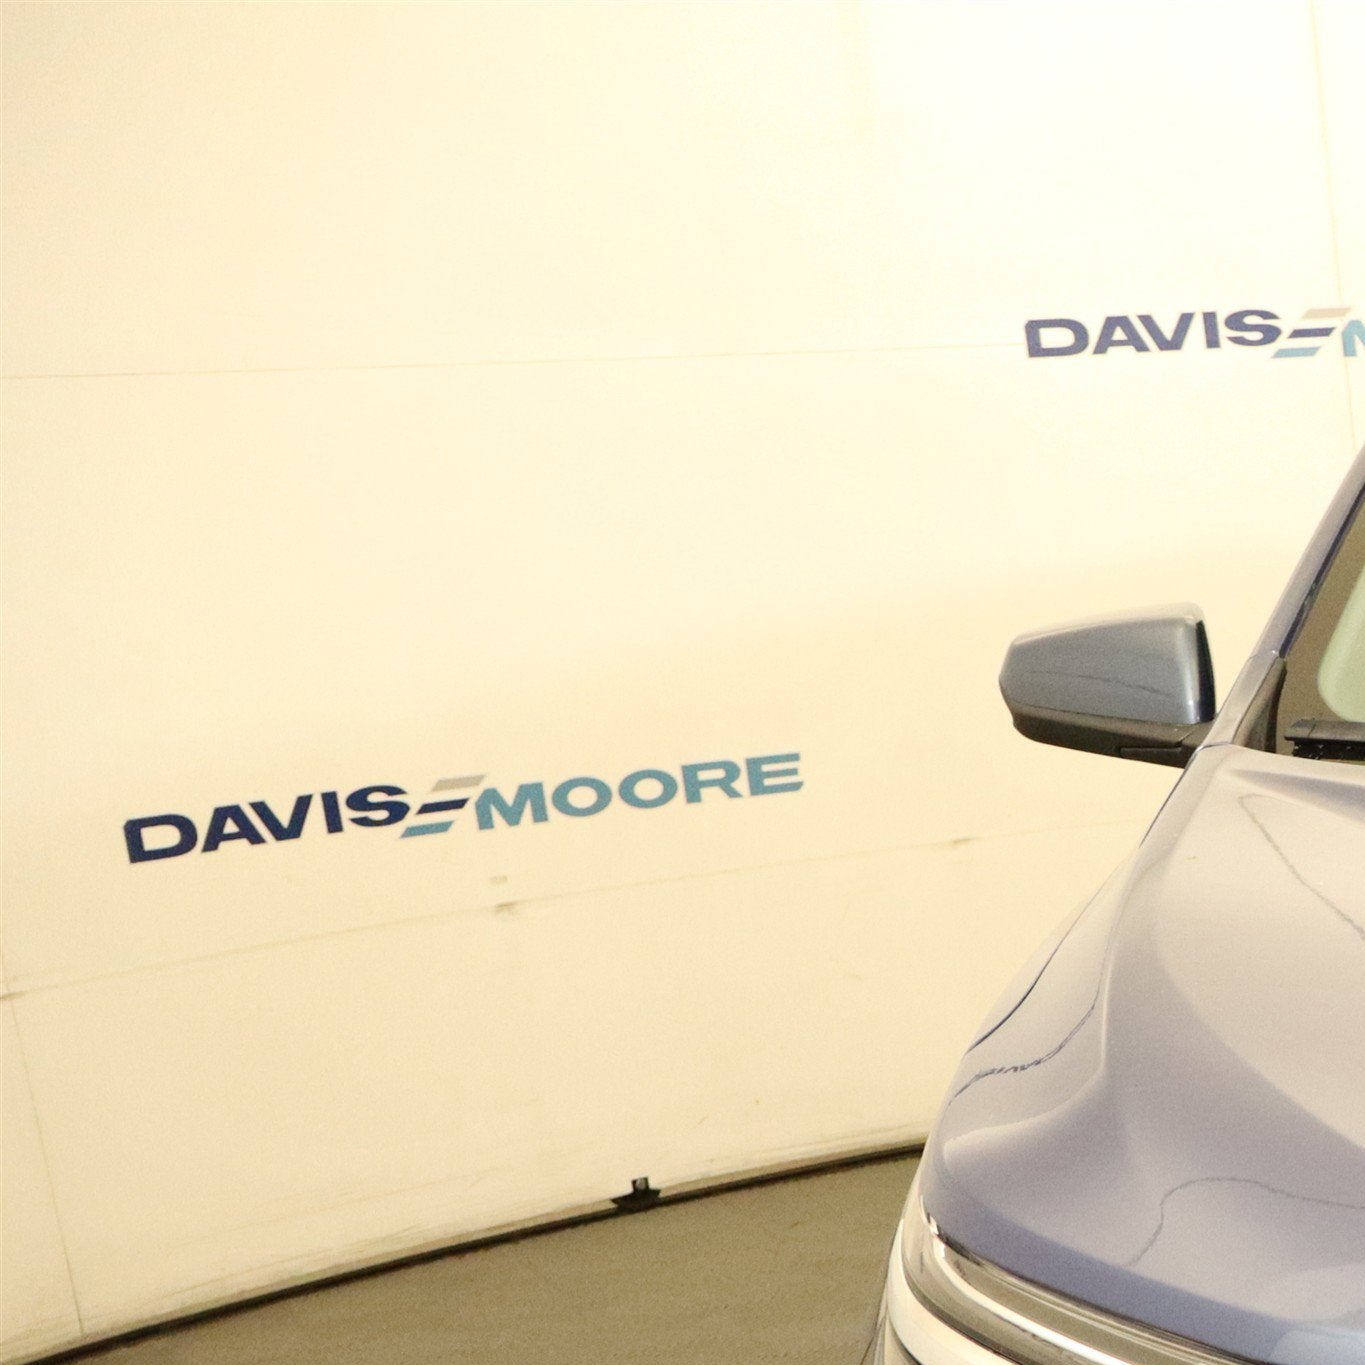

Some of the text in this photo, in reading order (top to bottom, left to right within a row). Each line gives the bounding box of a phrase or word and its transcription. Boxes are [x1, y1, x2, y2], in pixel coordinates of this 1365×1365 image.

[1024, 309, 1282, 358] DAVIS
[123, 752, 804, 864] DAVIS MOORE
